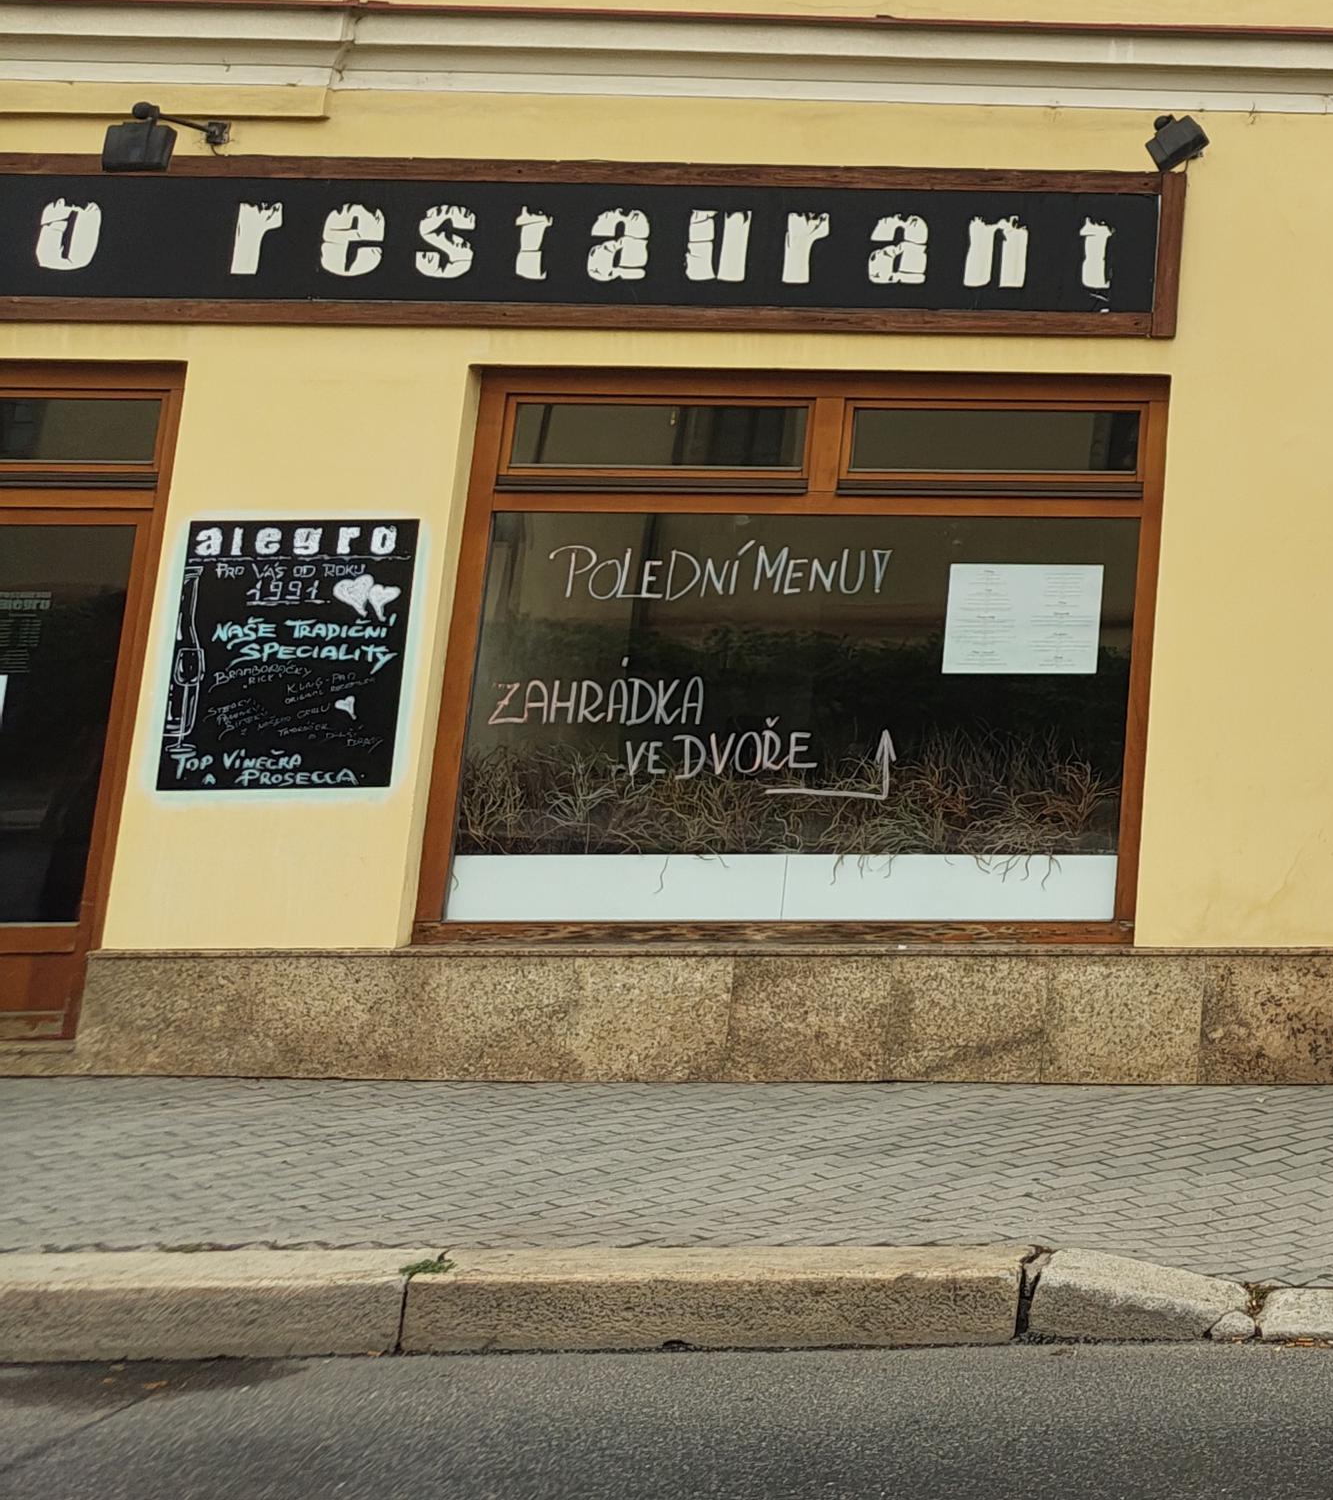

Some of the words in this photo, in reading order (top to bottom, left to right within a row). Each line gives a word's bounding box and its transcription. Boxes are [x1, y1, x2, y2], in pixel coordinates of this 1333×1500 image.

[229, 200, 1115, 290] restaurant
[195, 525, 398, 557] alegro
[215, 563, 245, 579] PRO
[293, 563, 316, 578] OD
[323, 563, 366, 578] ROKU
[549, 540, 757, 601] POLEDNÍ
[211, 617, 277, 644] NAŠE
[283, 613, 397, 639] TRADIČNÍ
[226, 645, 398, 674] SPECIALITY
[488, 657, 705, 727] ZAHRÁDKA
[625, 740, 667, 776] VE
[672, 716, 818, 780] DVOŘE
[171, 751, 214, 779] TOP
[201, 772, 217, 786] A
